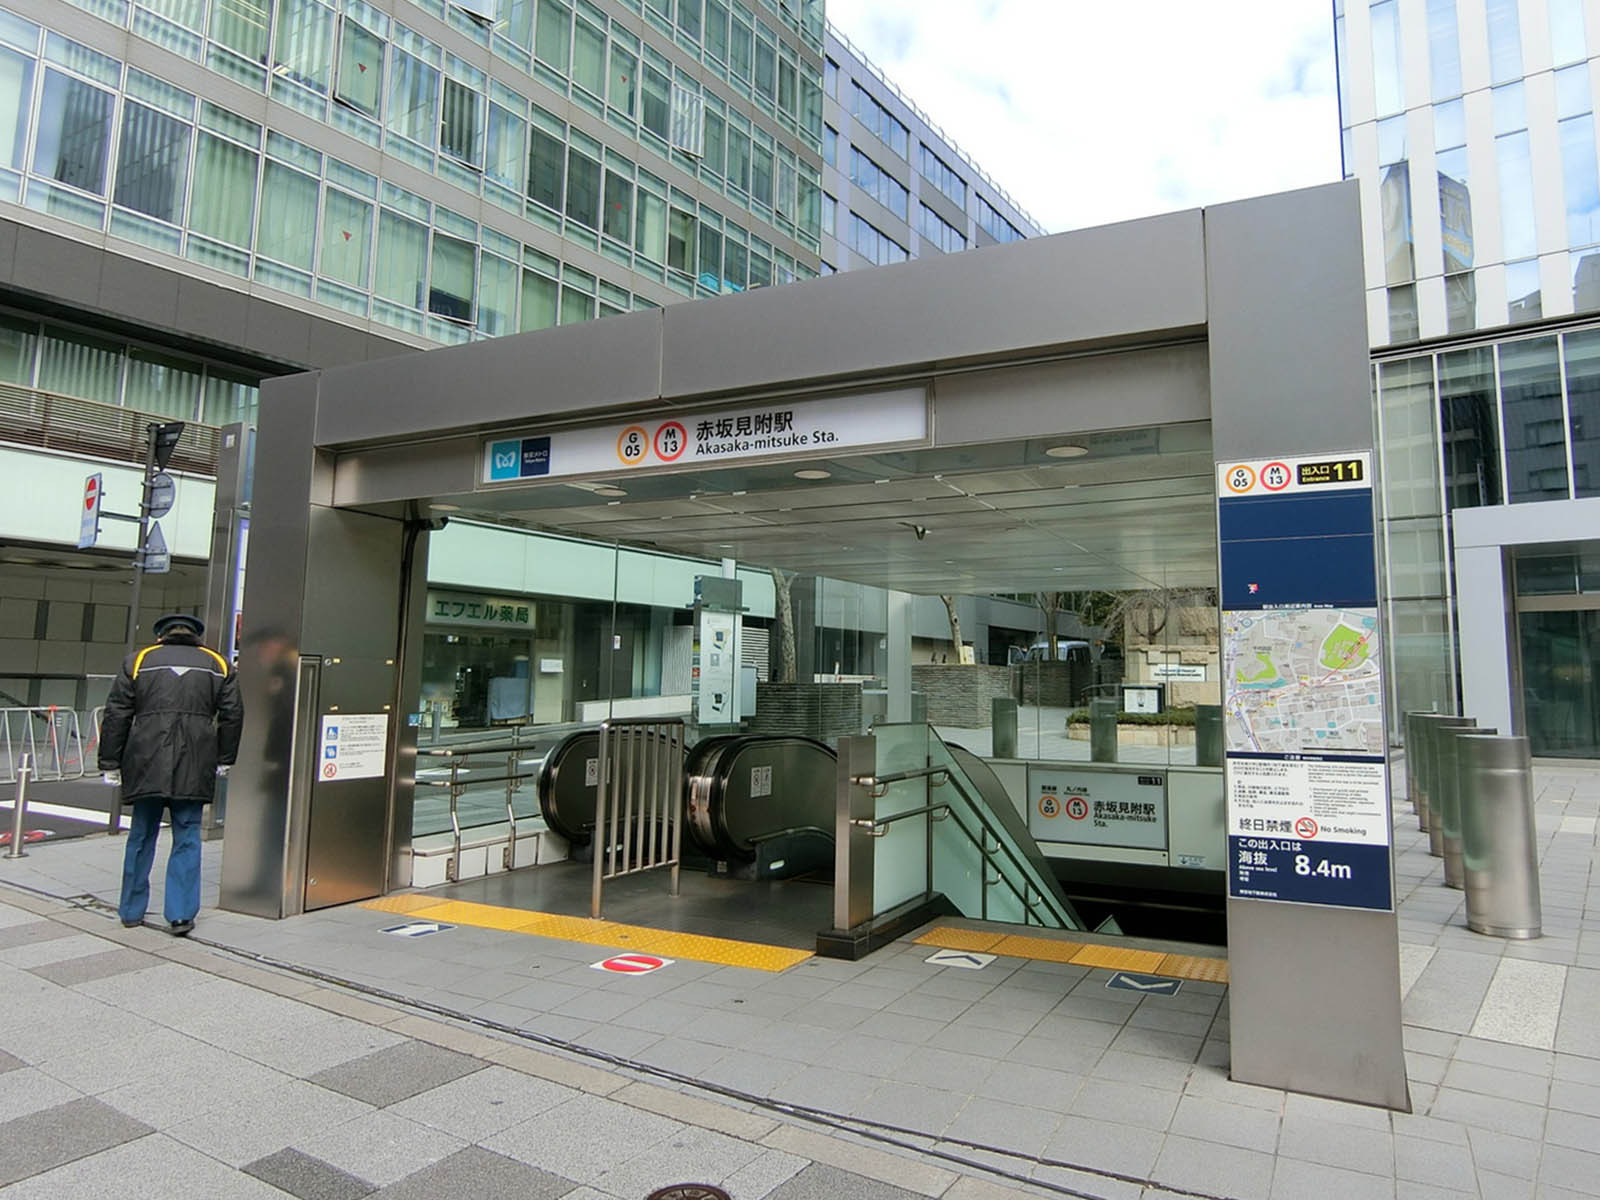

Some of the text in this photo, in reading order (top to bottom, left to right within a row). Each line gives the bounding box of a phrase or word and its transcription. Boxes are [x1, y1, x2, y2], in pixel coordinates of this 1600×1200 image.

[695, 411, 793, 441] 赤坂見附駅
[629, 433, 637, 443] G
[665, 429, 676, 439] M
[663, 441, 678, 453] 13
[695, 430, 839, 455] Akasaka-mitsuke Sta.
[625, 445, 641, 457] 05
[1236, 470, 1245, 478] G
[1270, 467, 1280, 475] M
[1301, 465, 1329, 476] 出入口
[1333, 462, 1358, 480] 11
[1233, 478, 1248, 487] 05
[1269, 476, 1283, 485] 13
[435, 600, 529, 624] エフエル薬局
[1093, 801, 1156, 815] 赤坂見附駅
[1239, 818, 1292, 833] 終日禁煙
[1333, 826, 1367, 836] Smoking
[1238, 838, 1302, 851] この出入口は
[1238, 850, 1268, 865] 海抜
[1295, 854, 1352, 879] 8.4m
